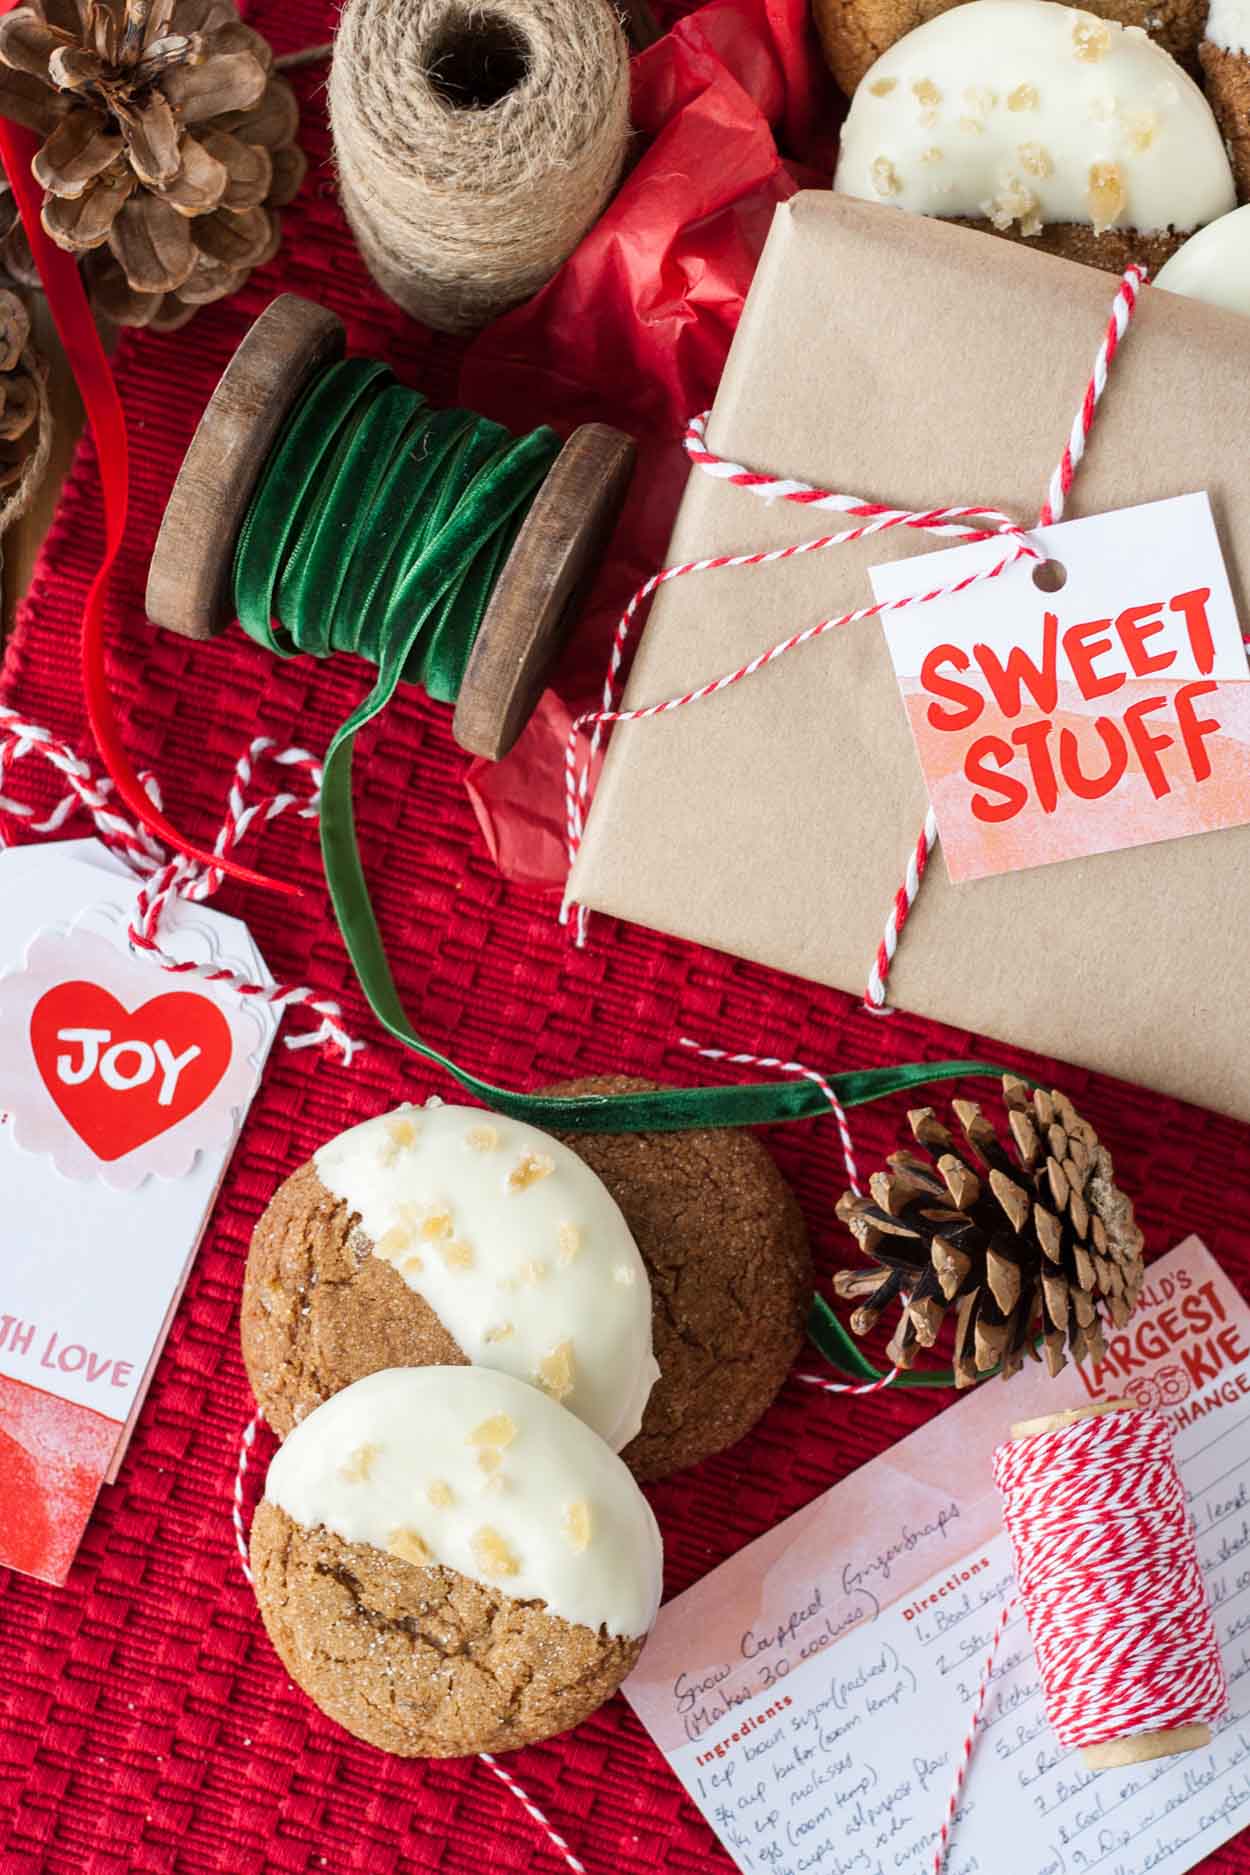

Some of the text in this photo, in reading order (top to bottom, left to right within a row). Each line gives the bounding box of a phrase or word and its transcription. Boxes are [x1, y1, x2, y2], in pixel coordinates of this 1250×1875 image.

[920, 586, 1216, 732] SWEET
[963, 680, 1223, 824] STUFF
[56, 1027, 202, 1106] JOY
[40, 1330, 136, 1389] LOVE
[1074, 1279, 1227, 1399] LARGEST
[1106, 1323, 1250, 1403] OOKIE
[1166, 1371, 1250, 1437] CHANGE
[901, 1557, 990, 1622] Directions
[674, 1664, 731, 1716] Snow
[740, 1588, 824, 1659] Capped
[757, 1659, 794, 1689] 30
[696, 1696, 793, 1767] Ingredients
